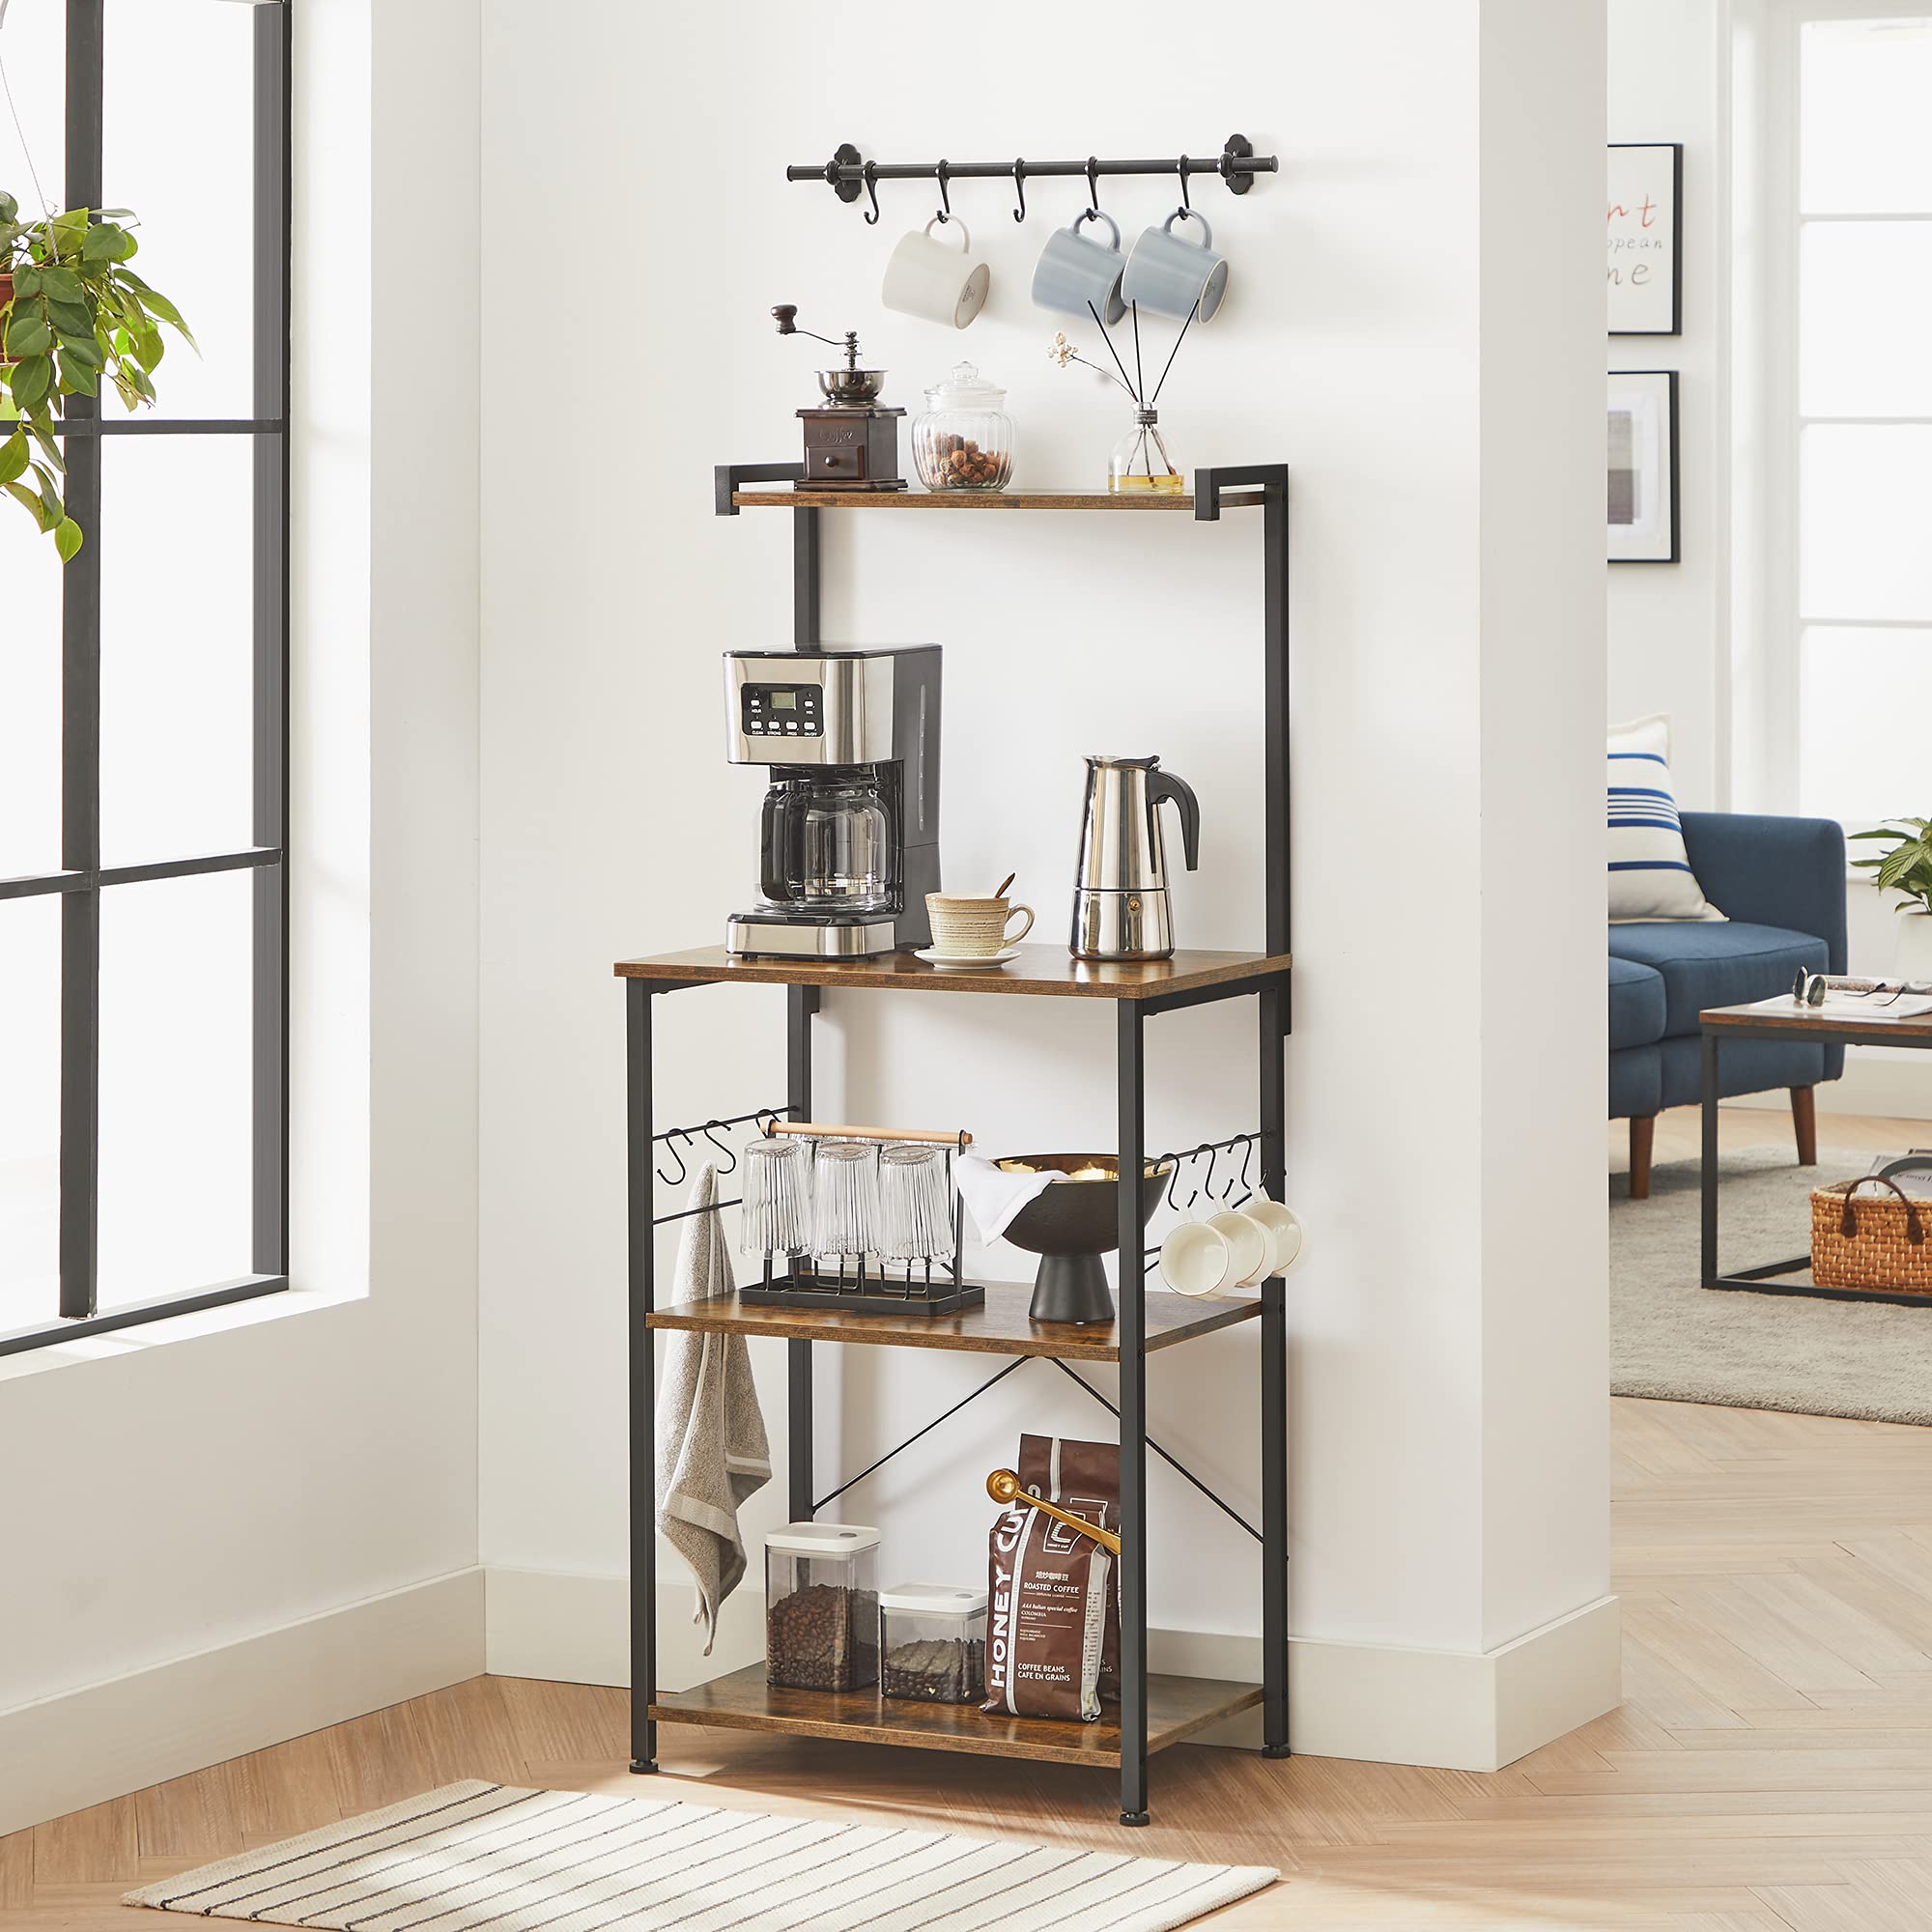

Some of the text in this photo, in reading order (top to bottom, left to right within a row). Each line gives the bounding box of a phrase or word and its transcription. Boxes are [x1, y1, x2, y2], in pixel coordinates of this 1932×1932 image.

[1024, 1581, 1079, 1594] ROASTED COFFEE
[990, 1564, 1011, 1688] HONEY
[1018, 1662, 1041, 1671] COFFEE
